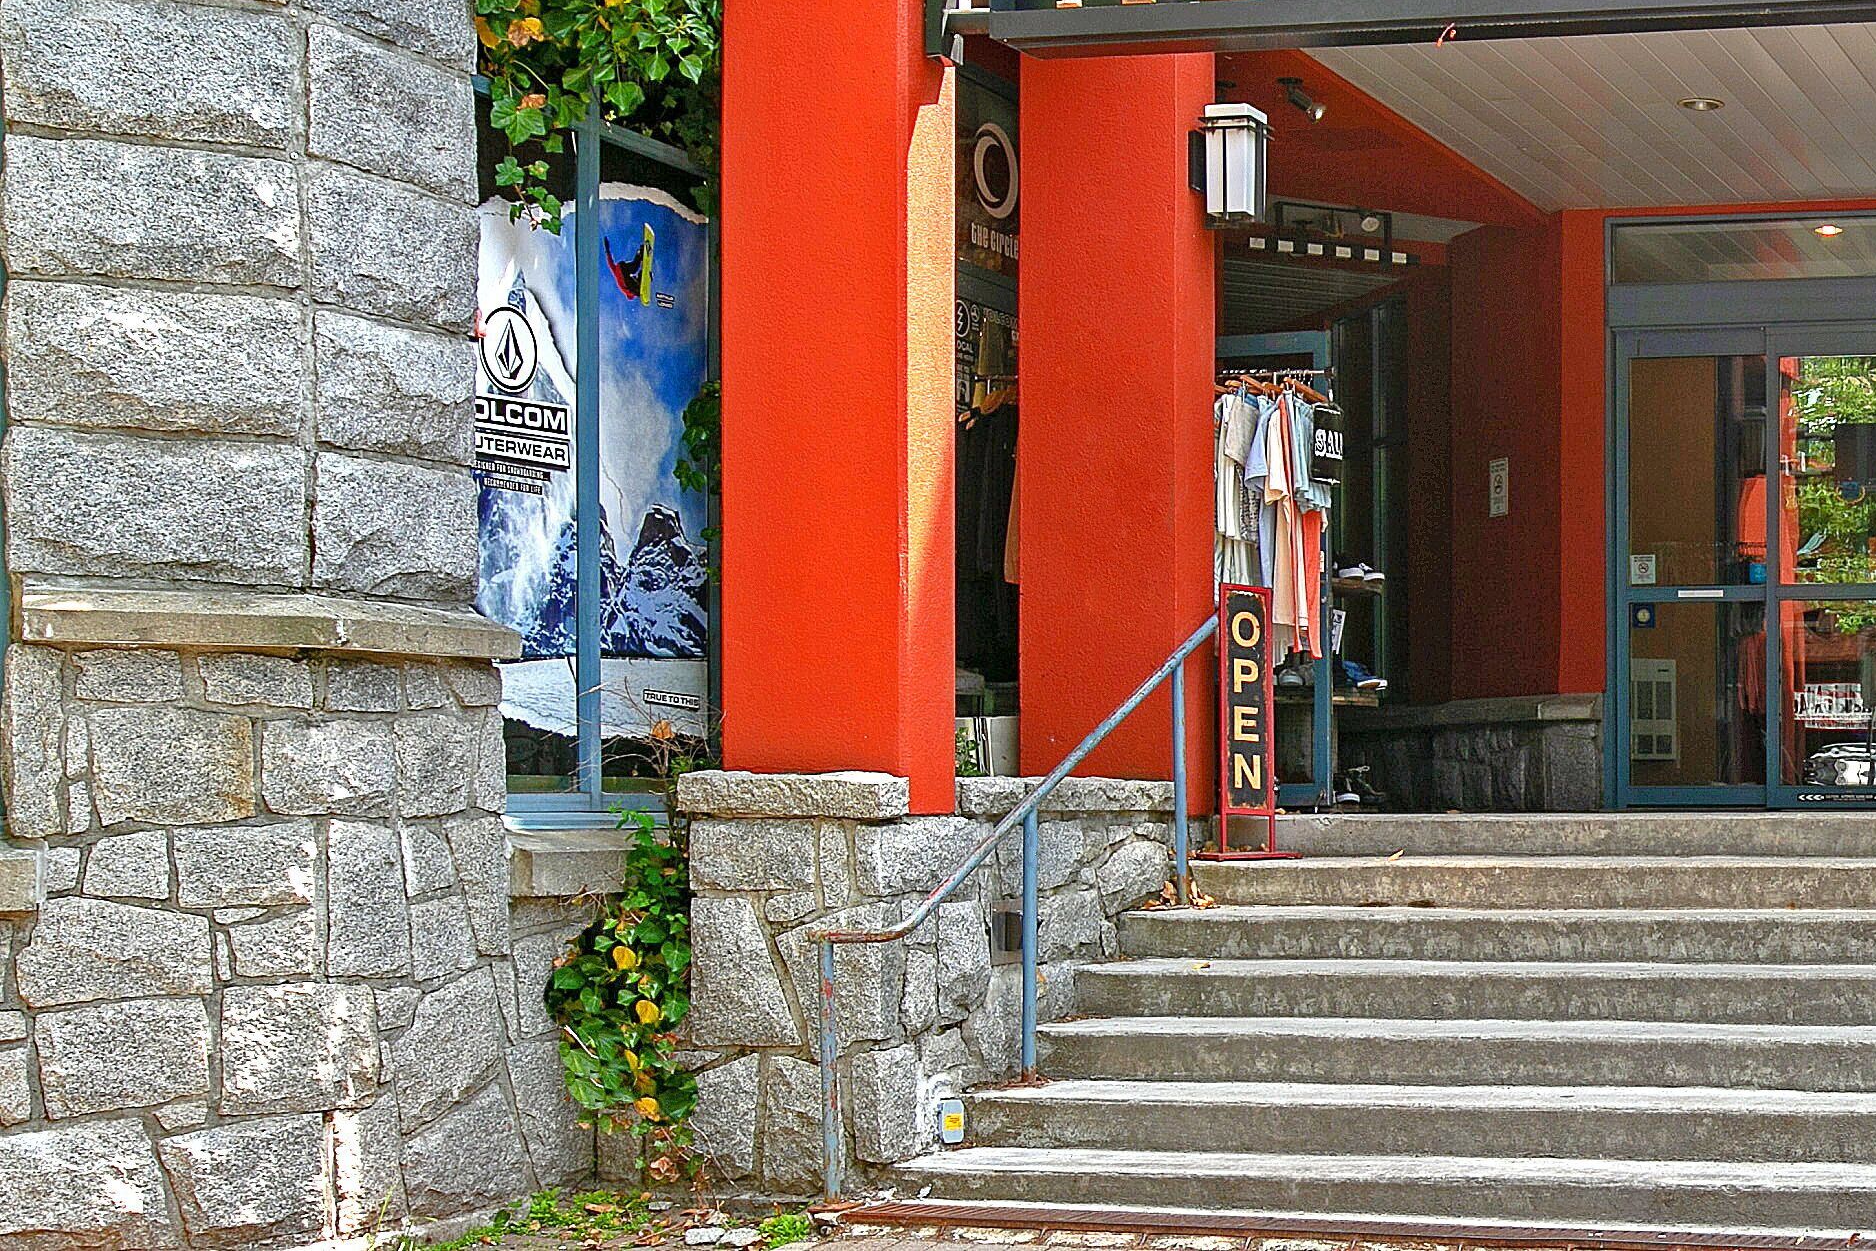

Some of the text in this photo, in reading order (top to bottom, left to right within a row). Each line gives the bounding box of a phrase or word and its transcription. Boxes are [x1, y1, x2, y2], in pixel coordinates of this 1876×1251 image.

[645, 693, 699, 706] TRUE TO THIS
[1231, 611, 1261, 790] OPEN
